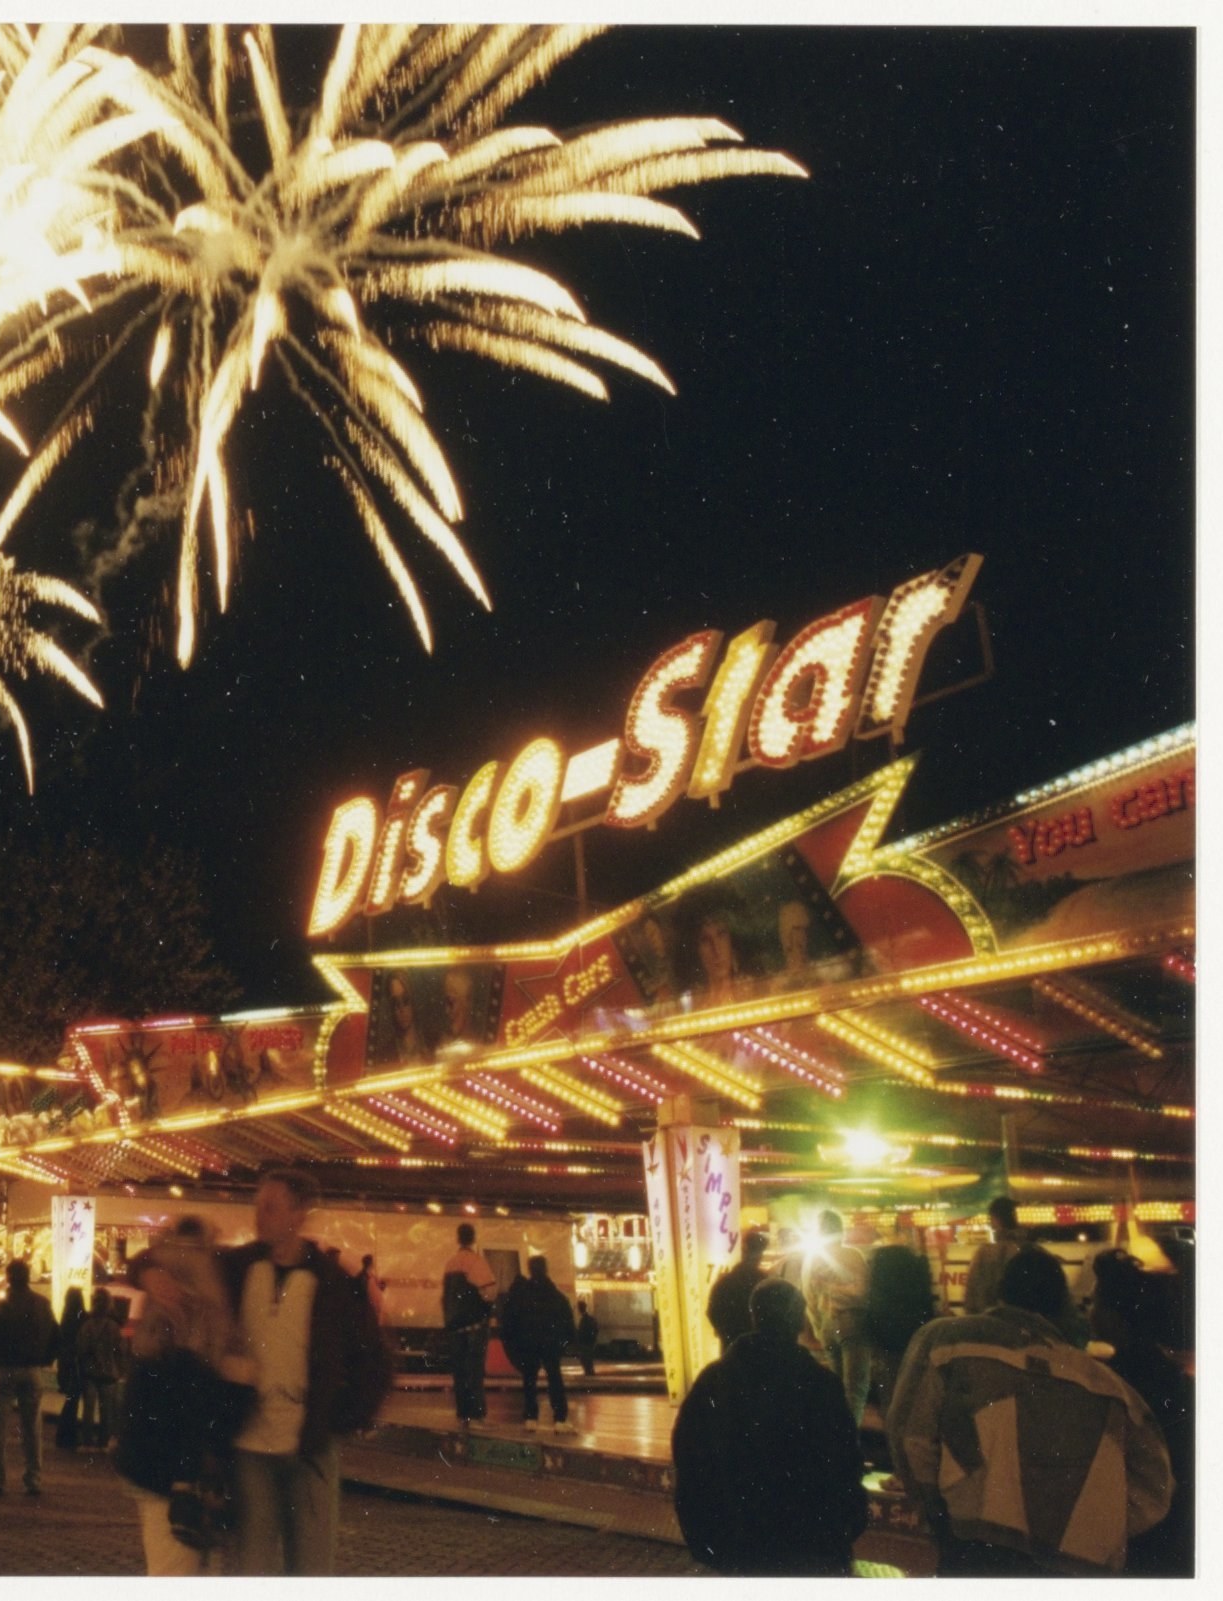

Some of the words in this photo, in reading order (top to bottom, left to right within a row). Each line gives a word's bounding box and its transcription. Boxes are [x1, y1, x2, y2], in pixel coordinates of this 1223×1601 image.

[1007, 806, 1096, 865] You
[563, 953, 612, 1005] Cars
[697, 1133, 739, 1254] SIMPLY
